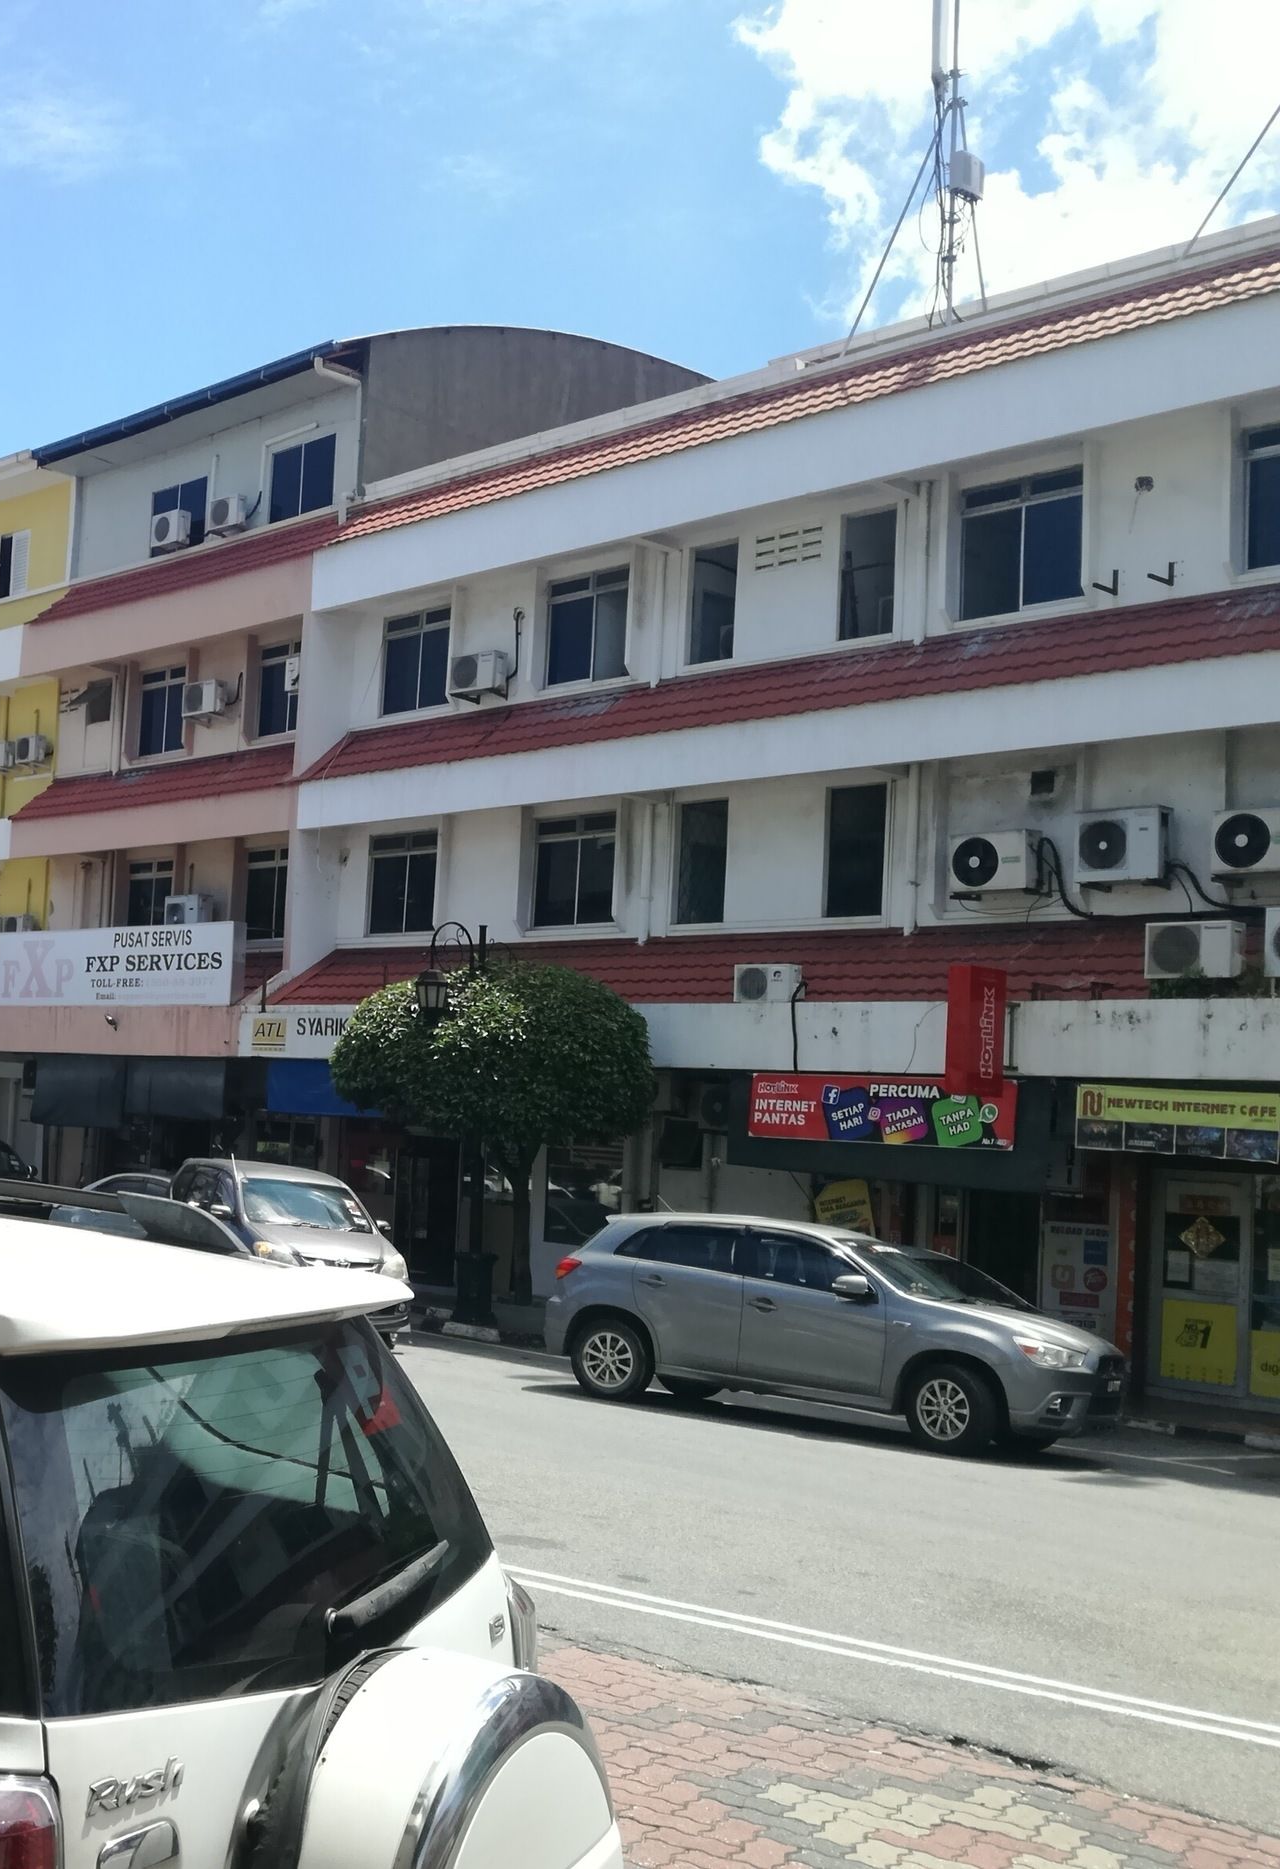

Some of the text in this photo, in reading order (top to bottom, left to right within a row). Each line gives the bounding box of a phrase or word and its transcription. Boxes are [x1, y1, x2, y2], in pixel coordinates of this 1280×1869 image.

[113, 929, 193, 948] PUSAT SERVIS
[1, 940, 74, 998] FXP
[85, 952, 223, 972] FXP SERVICES
[91, 978, 144, 988] TOLL-FREE:
[254, 1022, 285, 1038] ATL
[980, 986, 995, 1079] HOTLINK
[869, 1083, 940, 1099] PERCUMA
[755, 1099, 817, 1112] INTERNET
[831, 1103, 865, 1121] SETIAP
[885, 1106, 917, 1123] TIADA
[1107, 1097, 1277, 1117] NEWTECH INTERNET CAFE
[754, 1112, 806, 1126] PANTAS
[839, 1117, 863, 1131] HARI
[883, 1115, 925, 1135] BATASAN
[939, 1108, 974, 1127] TANPA
[948, 1121, 971, 1136] HAD
[87, 1755, 186, 1817] Rush
